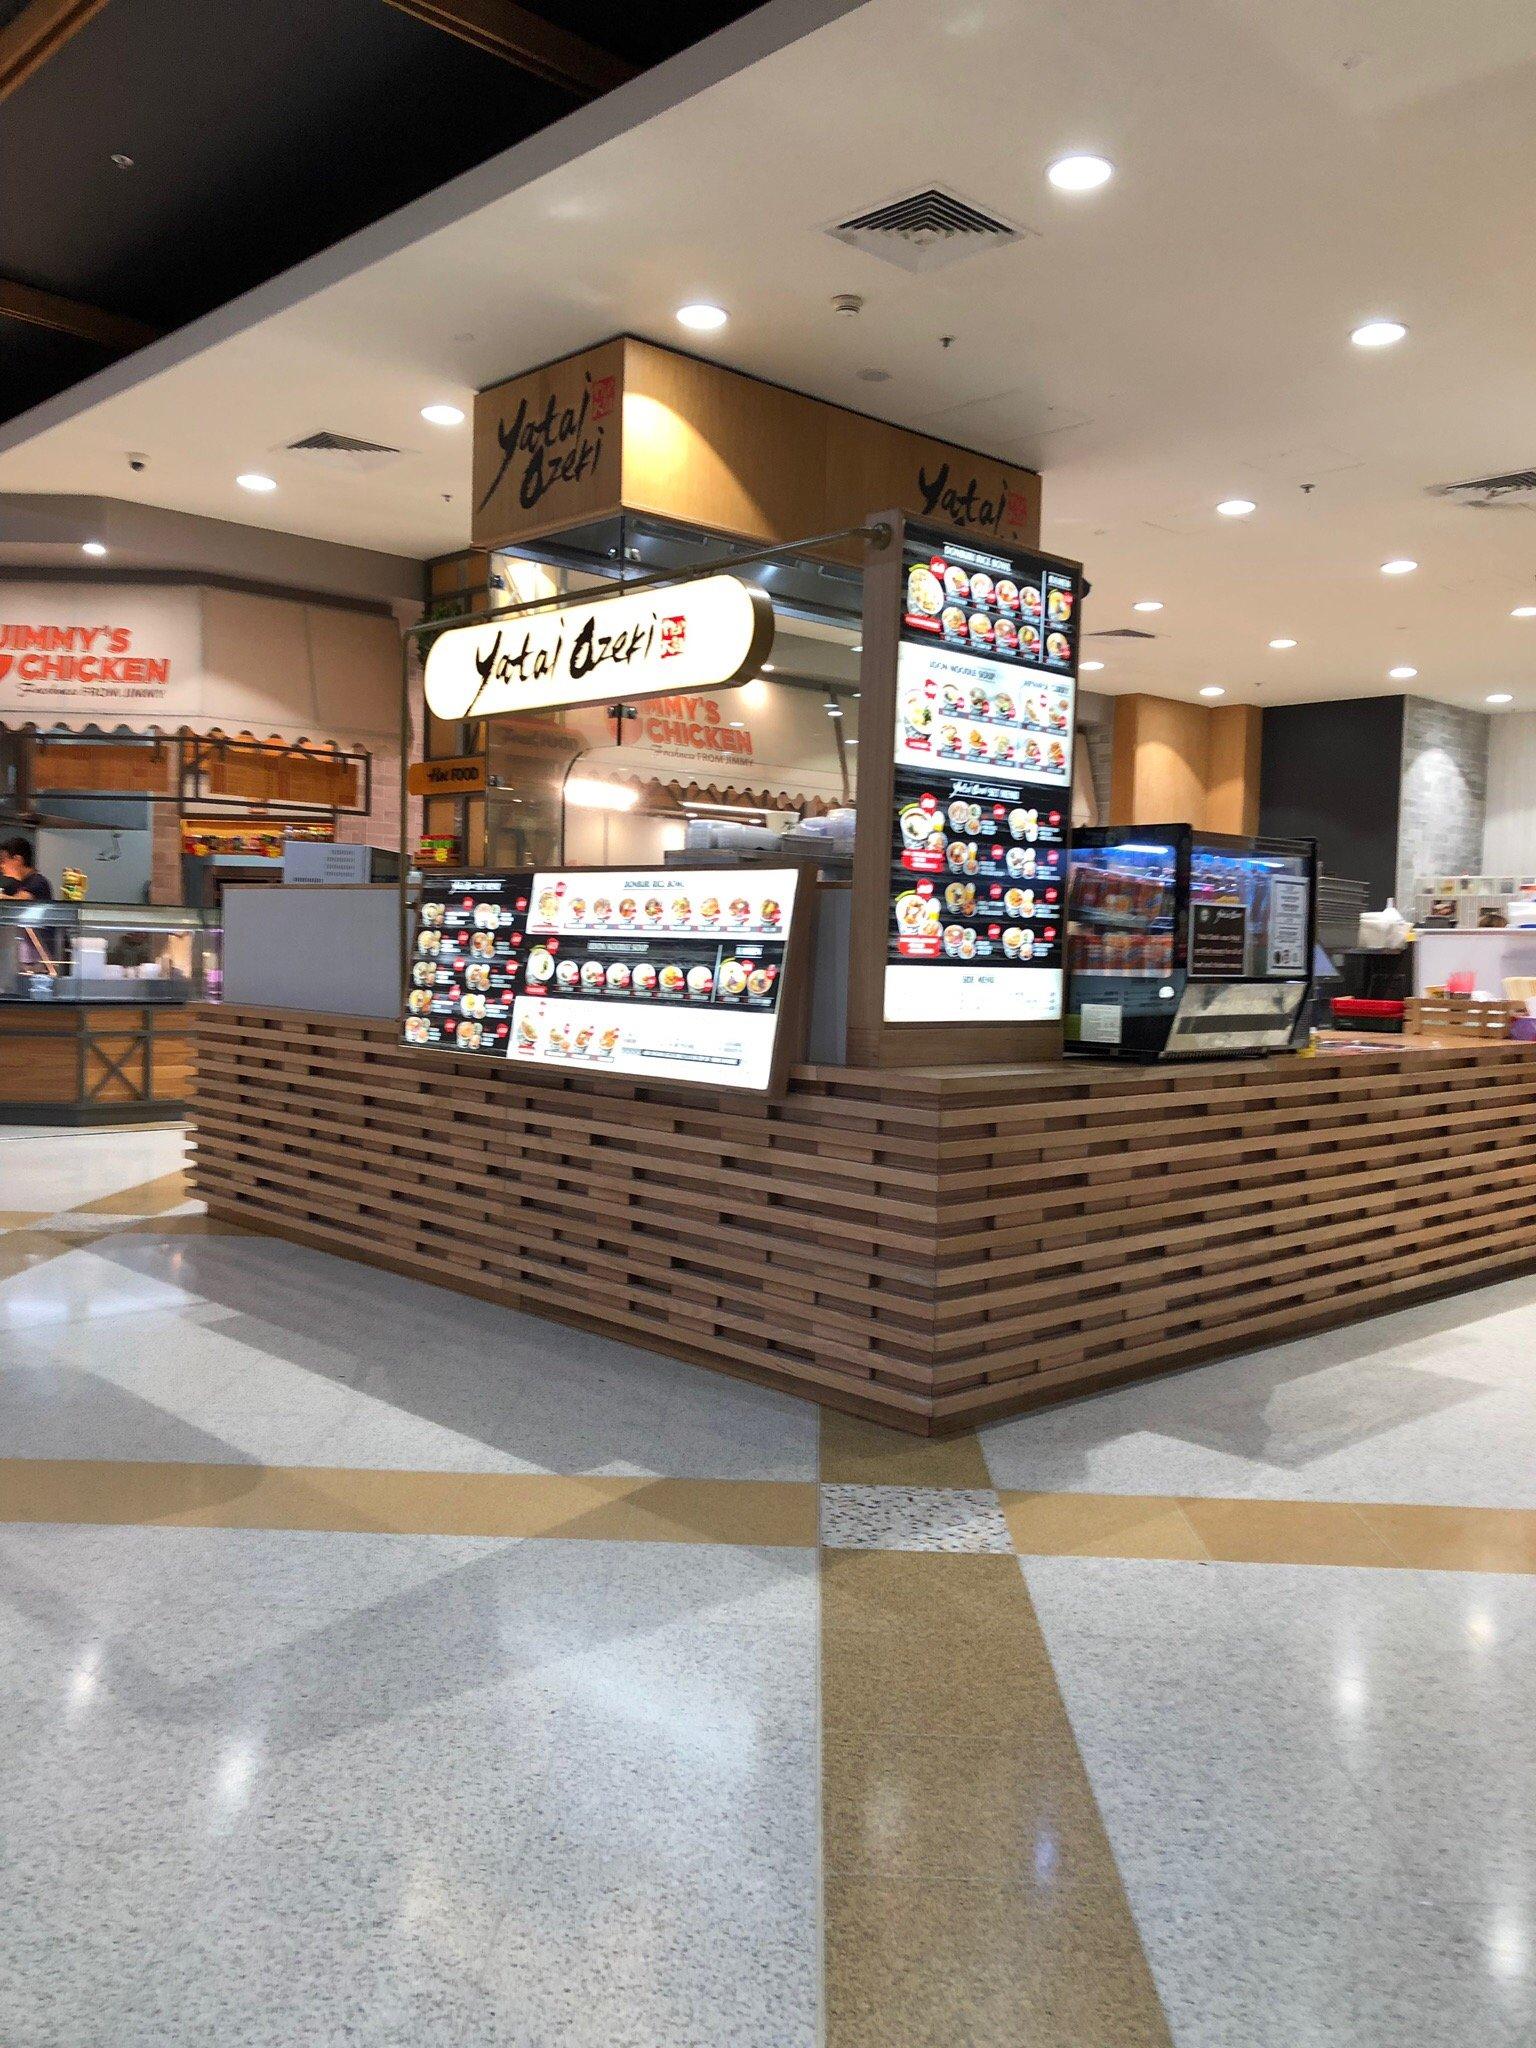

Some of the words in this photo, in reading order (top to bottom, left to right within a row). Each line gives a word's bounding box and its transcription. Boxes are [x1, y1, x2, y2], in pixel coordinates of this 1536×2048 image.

[477, 371, 592, 514] Yatai
[519, 426, 605, 510] Ozeki
[918, 463, 1008, 535] Yatai
[0, 624, 133, 654] JIMMY'S
[18, 653, 172, 685] CHICKEN
[463, 617, 565, 718] Yatai
[569, 612, 657, 679] Ozeki
[647, 717, 754, 756] CHICKEN
